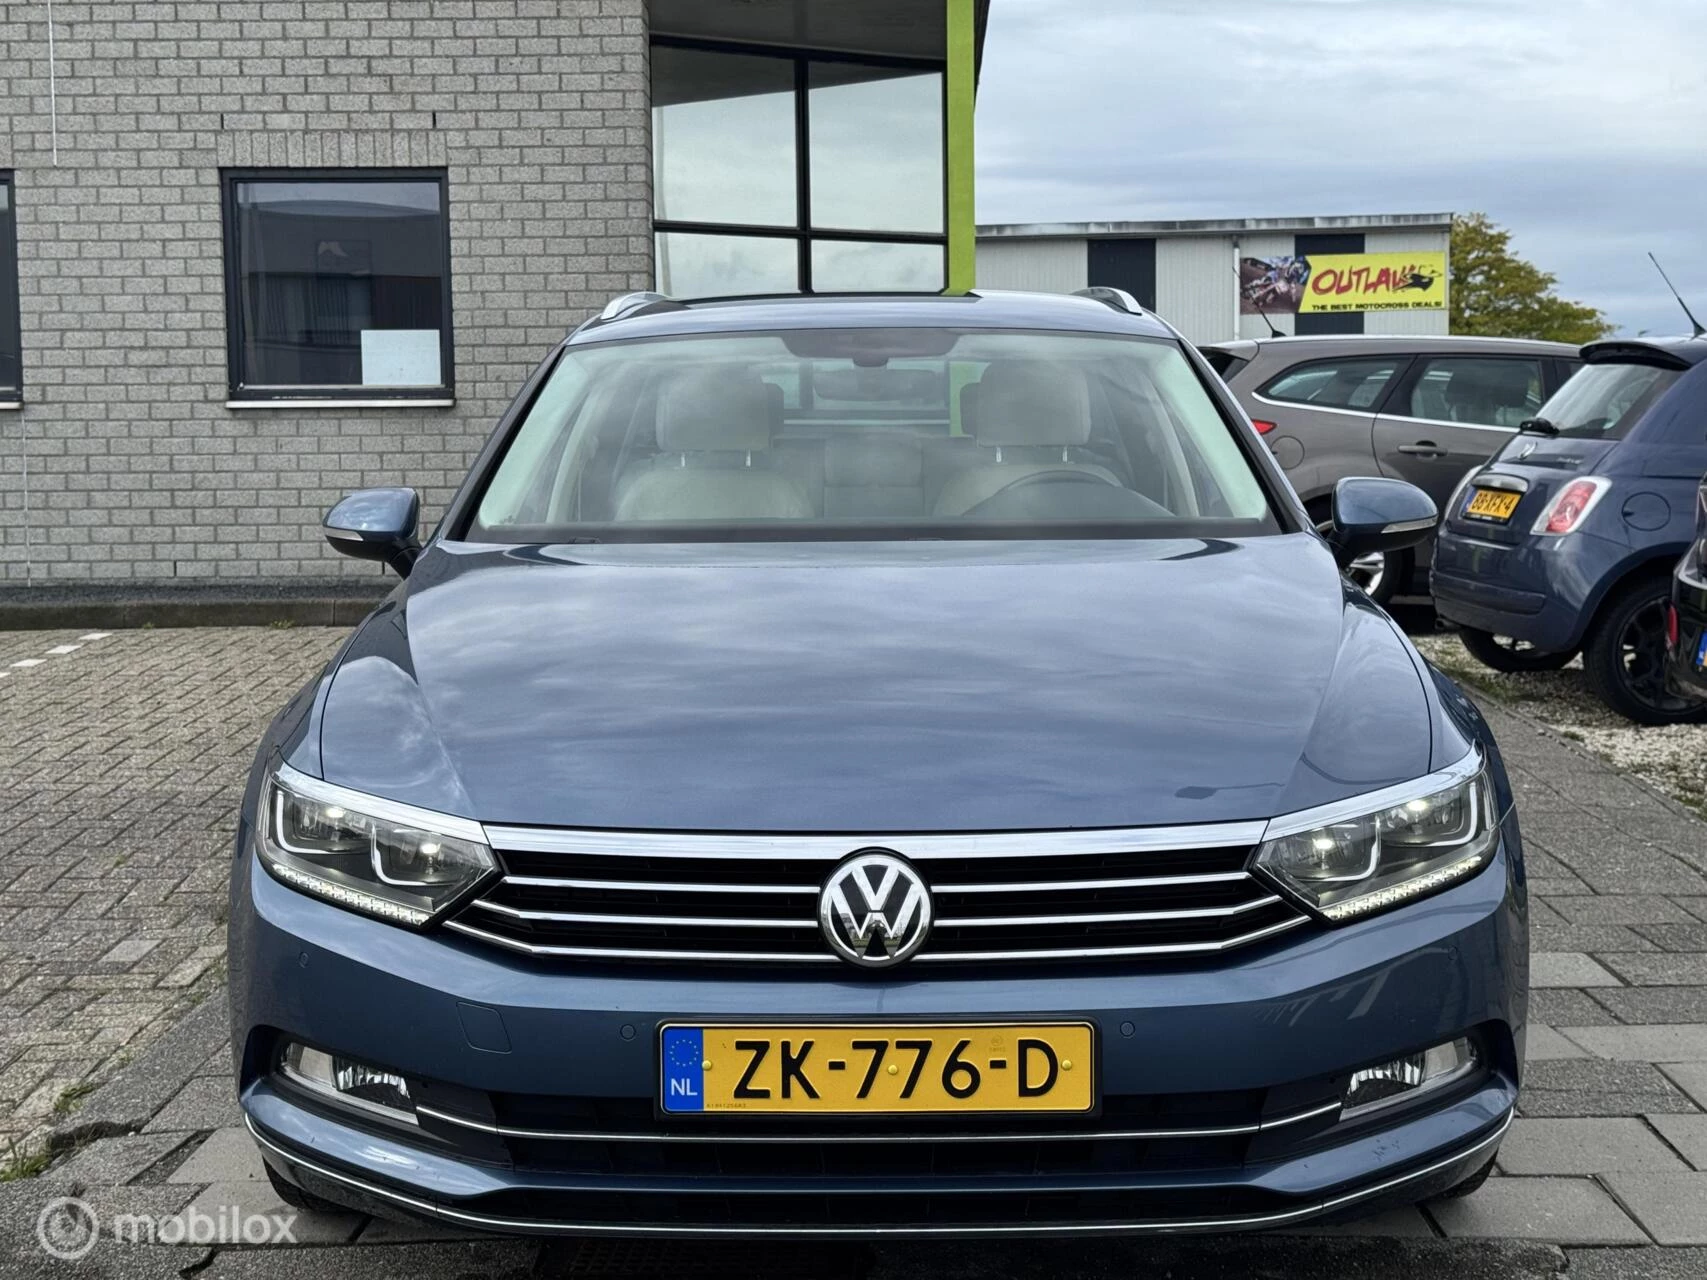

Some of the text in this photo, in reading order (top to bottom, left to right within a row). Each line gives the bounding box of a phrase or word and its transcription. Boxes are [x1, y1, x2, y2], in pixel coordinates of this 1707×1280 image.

[1355, 302, 1409, 310] MOTOCROSS
[670, 1038, 1059, 1100] NL ZK-776-D
